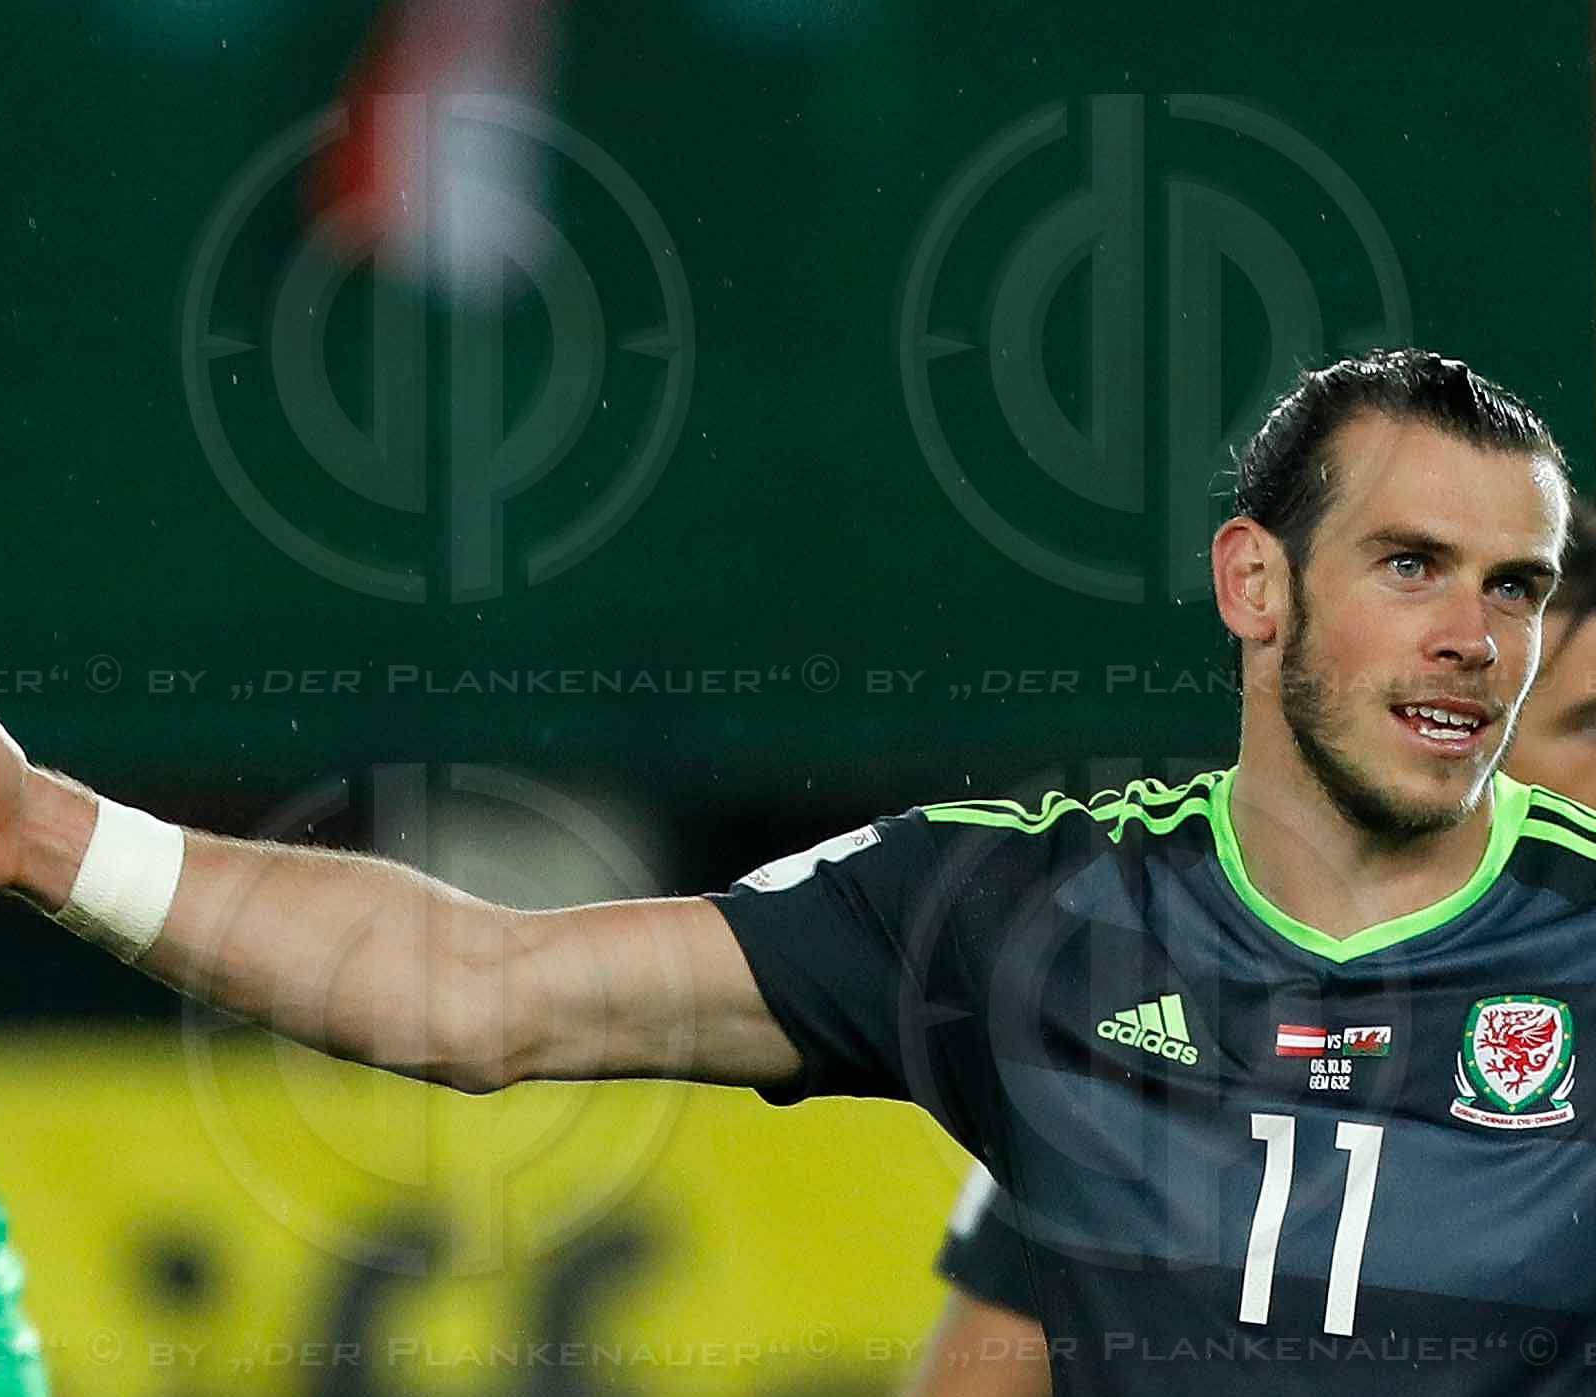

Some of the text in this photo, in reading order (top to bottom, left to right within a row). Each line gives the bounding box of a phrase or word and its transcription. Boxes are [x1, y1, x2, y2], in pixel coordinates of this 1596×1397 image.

[1096, 1018, 1199, 1067] adidas
[1327, 1034, 1342, 1050] VS
[1239, 1112, 1384, 1336] 11
